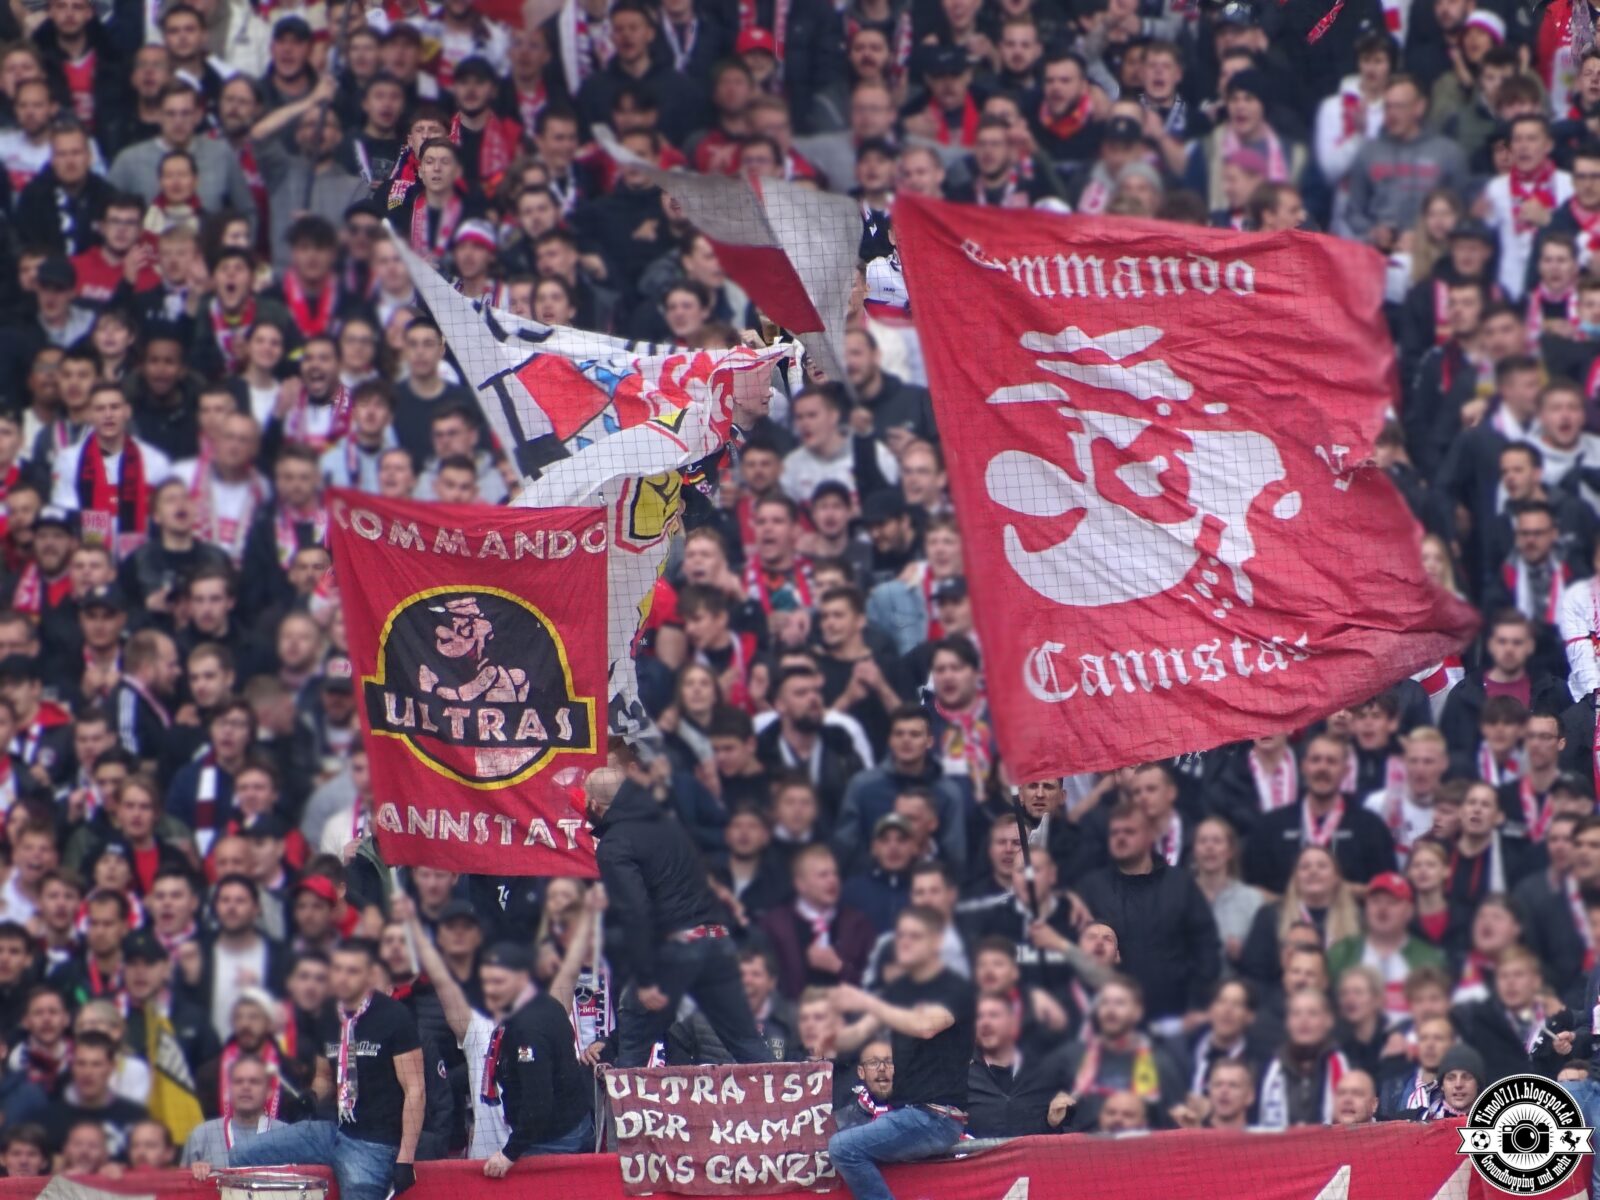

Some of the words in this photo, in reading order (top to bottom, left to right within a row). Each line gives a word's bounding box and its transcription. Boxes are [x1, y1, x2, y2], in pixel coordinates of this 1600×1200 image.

[384, 692, 572, 741] ULTRAS
[377, 802, 600, 851] ANNSTAT
[615, 1108, 691, 1142] DER
[709, 1102, 833, 1145] KAMPF
[620, 1153, 695, 1184] UMS
[705, 1151, 836, 1186] GANZE
